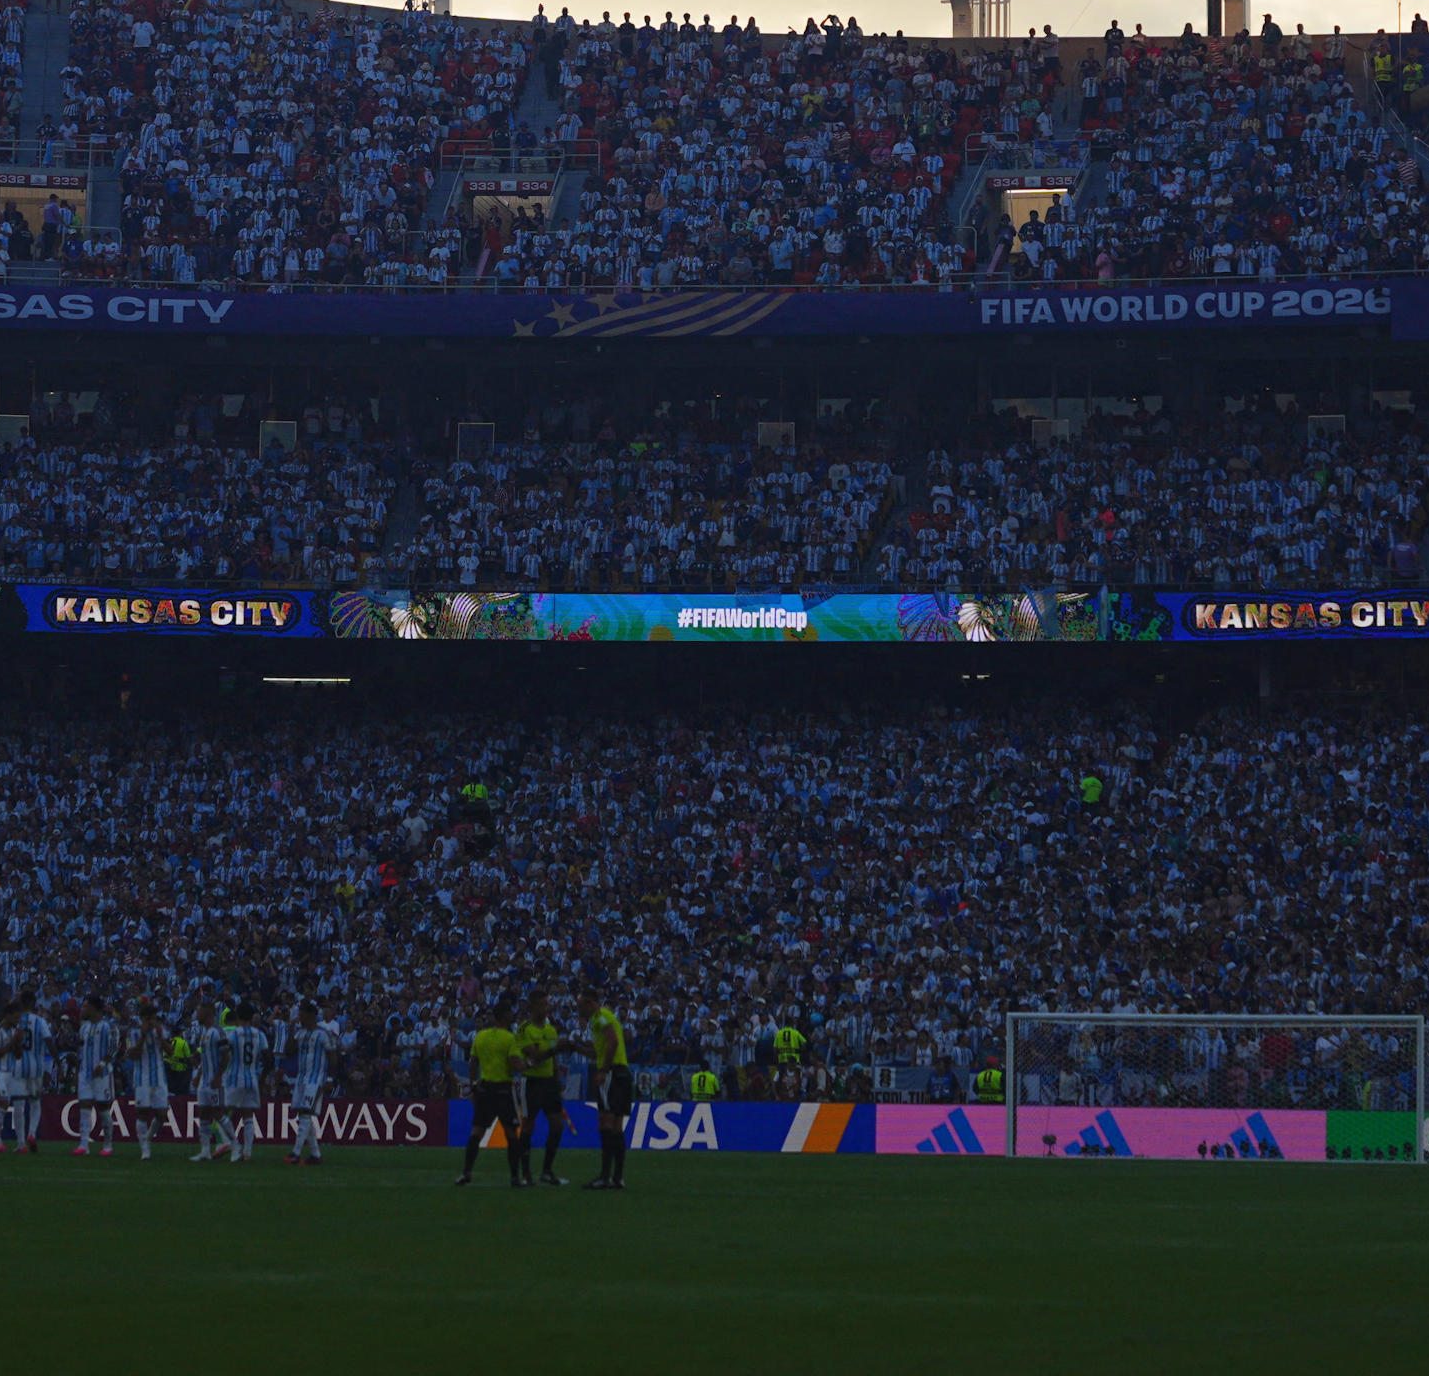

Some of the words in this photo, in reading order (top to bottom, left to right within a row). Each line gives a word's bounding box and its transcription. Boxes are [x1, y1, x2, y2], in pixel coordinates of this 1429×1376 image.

[0, 175, 26, 184] 332
[52, 176, 79, 185] 333
[469, 181, 496, 190] 333
[522, 181, 548, 190] 334
[993, 178, 1019, 187] 334
[106, 295, 235, 324] CITY
[980, 297, 1057, 324] FIFA
[1060, 294, 1189, 322] WORLD
[1194, 291, 1267, 320] CUP
[1271, 287, 1391, 317] 2026
[56, 597, 200, 624] KANSAS
[210, 600, 292, 626] CITY
[677, 607, 807, 631] #FIFAWorldCup
[1195, 601, 1341, 629] KANSAS
